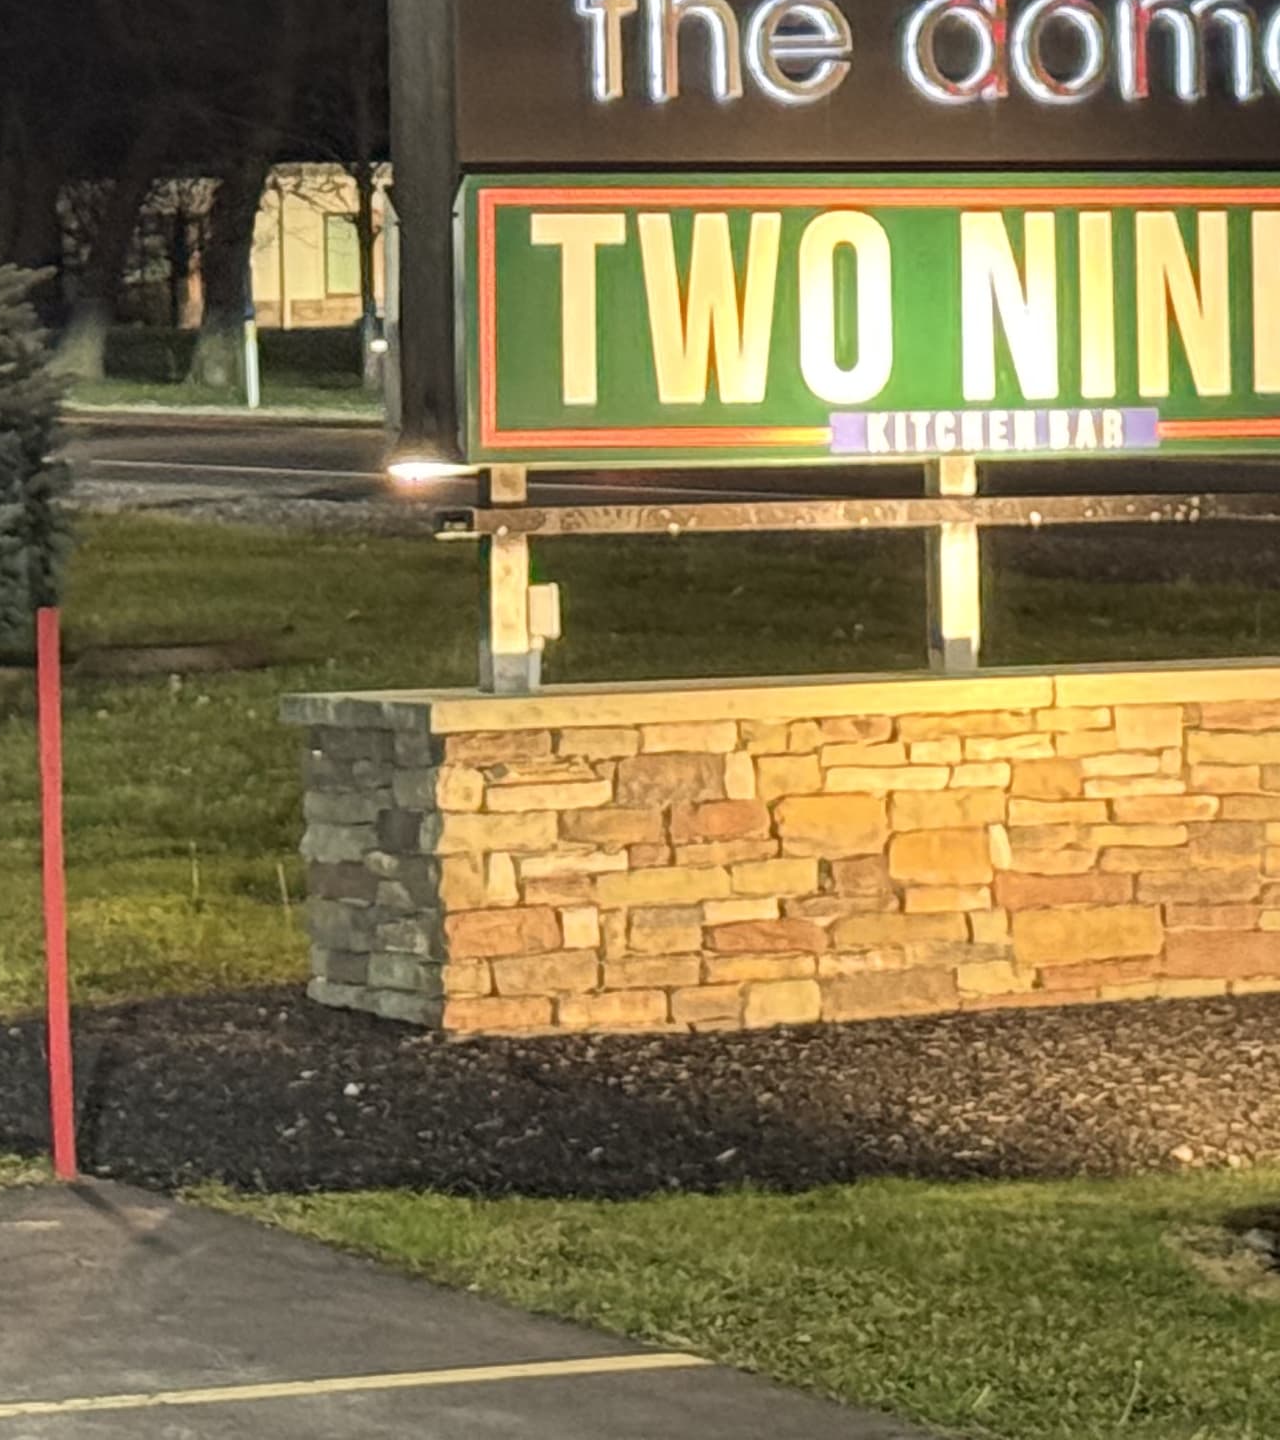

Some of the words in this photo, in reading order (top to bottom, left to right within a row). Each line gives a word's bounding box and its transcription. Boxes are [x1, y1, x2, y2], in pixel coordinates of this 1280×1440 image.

[530, 209, 894, 405] TWO
[866, 409, 1037, 453] KITCHEN
[1048, 408, 1124, 450] BAR
